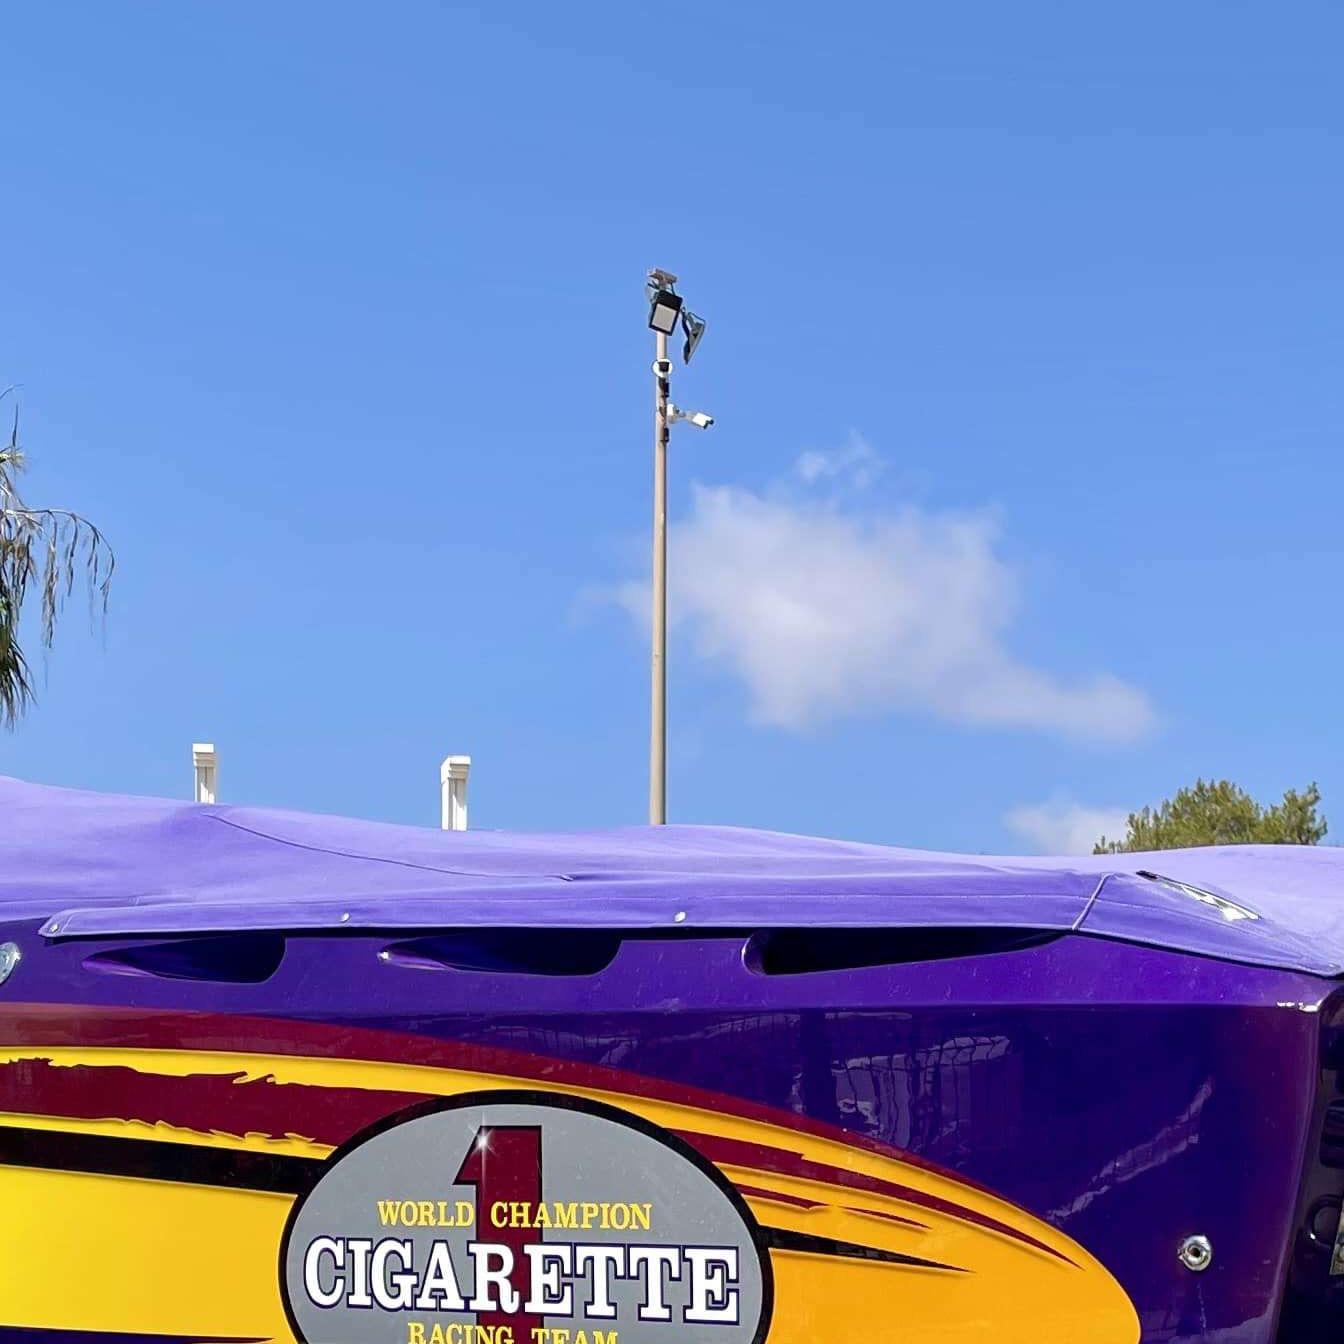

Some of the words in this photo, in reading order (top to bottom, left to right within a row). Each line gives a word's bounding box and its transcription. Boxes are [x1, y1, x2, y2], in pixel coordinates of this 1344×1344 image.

[377, 1199, 475, 1229] WORLD
[490, 1201, 653, 1231] CHAMPION
[304, 1235, 741, 1325] CIGARETTE
